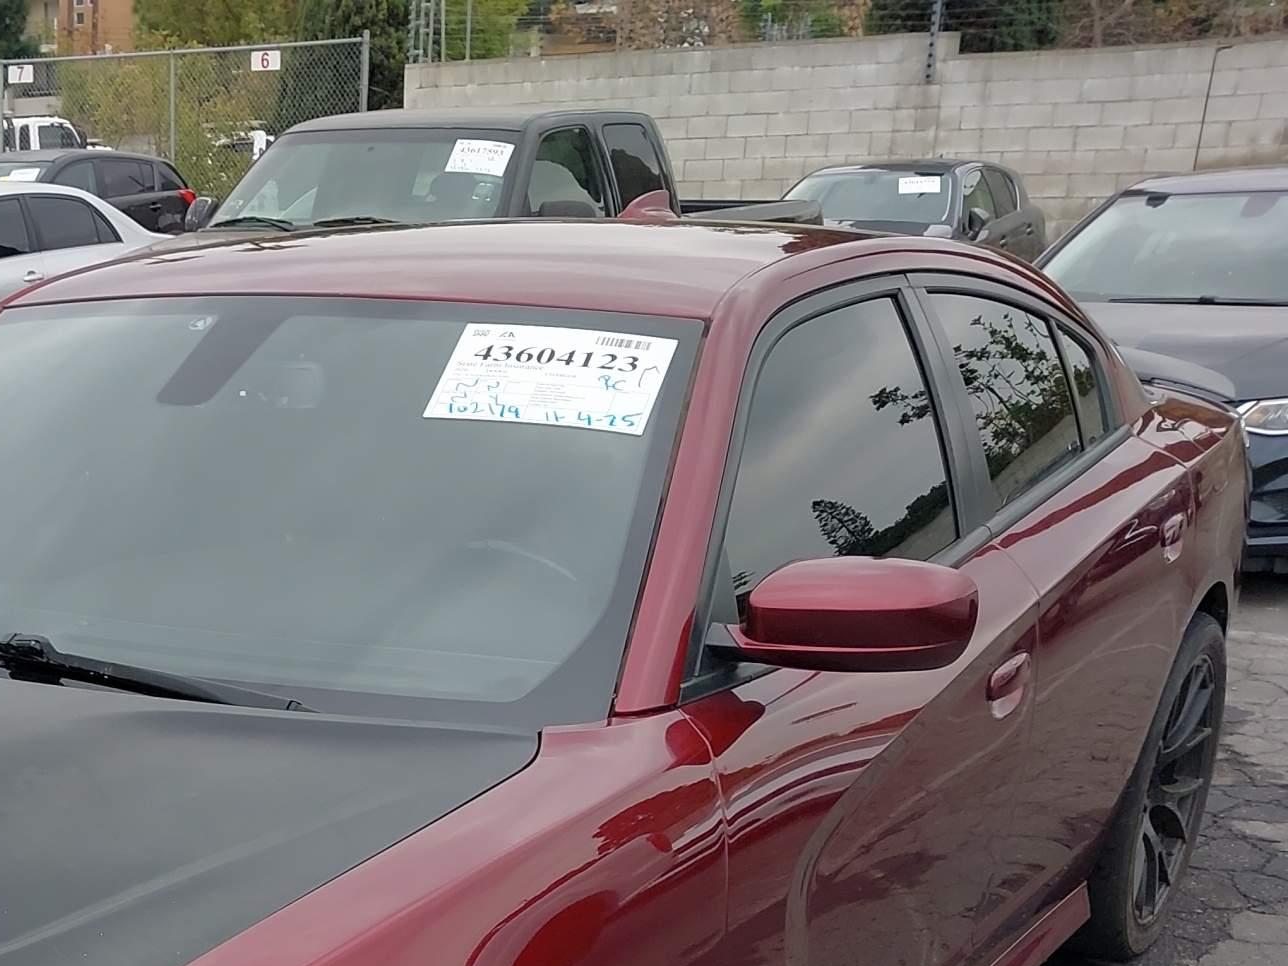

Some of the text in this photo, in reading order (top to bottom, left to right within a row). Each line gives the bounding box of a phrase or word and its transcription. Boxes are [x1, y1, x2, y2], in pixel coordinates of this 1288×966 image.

[261, 52, 270, 69] 6
[16, 66, 24, 81] 7
[474, 344, 639, 373] 43604123
